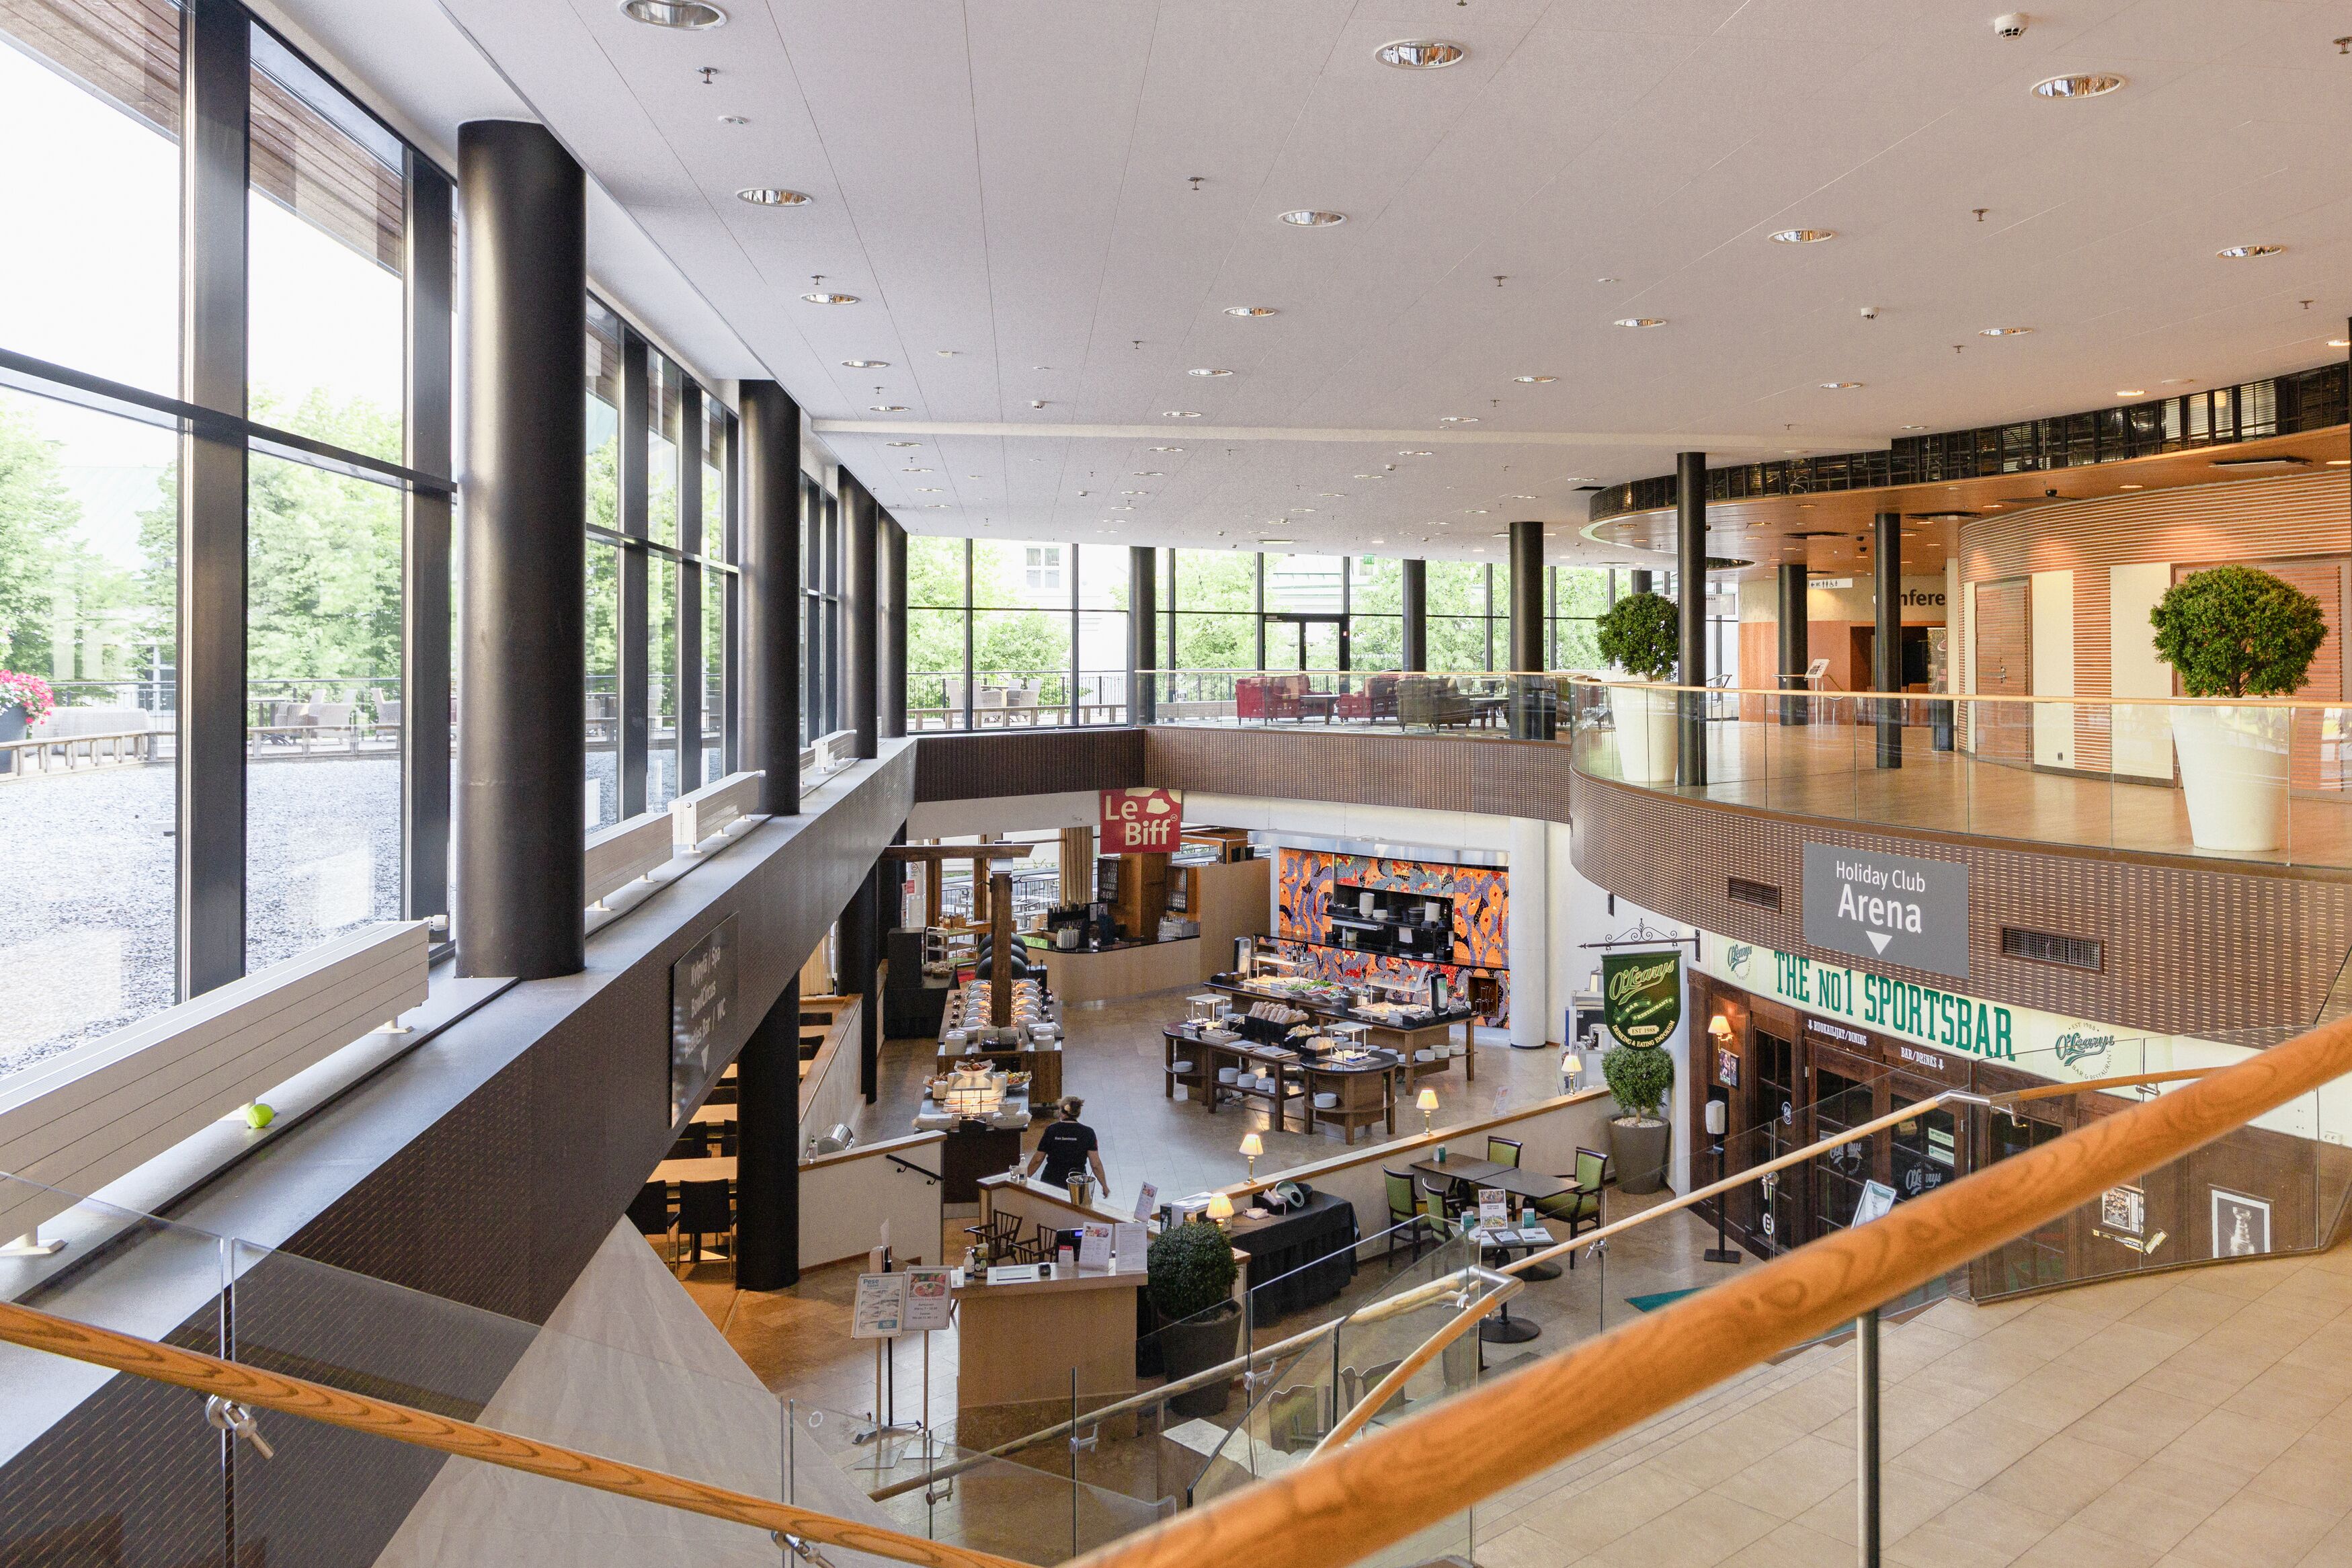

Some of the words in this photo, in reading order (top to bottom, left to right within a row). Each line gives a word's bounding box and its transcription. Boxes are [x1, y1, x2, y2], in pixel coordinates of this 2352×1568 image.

[1106, 796, 1138, 820] Le
[1125, 819, 1170, 845] Biff
[1836, 860, 1888, 891] Holiday
[1892, 870, 1926, 893] Club
[1838, 884, 1922, 934] Arena
[712, 946, 721, 968] Spa
[1609, 960, 1675, 1005] O'Learys
[702, 1016, 711, 1038] Bar
[717, 997, 726, 1021] WC
[1625, 1002, 1639, 1014] BAR
[1637, 999, 1668, 1020] RESTAURANT
[1774, 950, 1810, 1003] THE
[1865, 973, 2016, 1062] SPORTSBAR
[1612, 1024, 1633, 1045] DRINKING
[1636, 1039, 1655, 1048] EATING
[1654, 1020, 1675, 1044] EMPORIUM
[2084, 1022, 2096, 1031] 1988
[1900, 1046, 1937, 1068] BAR/DRINKS
[2056, 1032, 2115, 1067] O'Learys
[2072, 1065, 2083, 1077] BAR
[2090, 1050, 2112, 1080] RESTAURANT
[1906, 1169, 1942, 1195] O'Lerys
